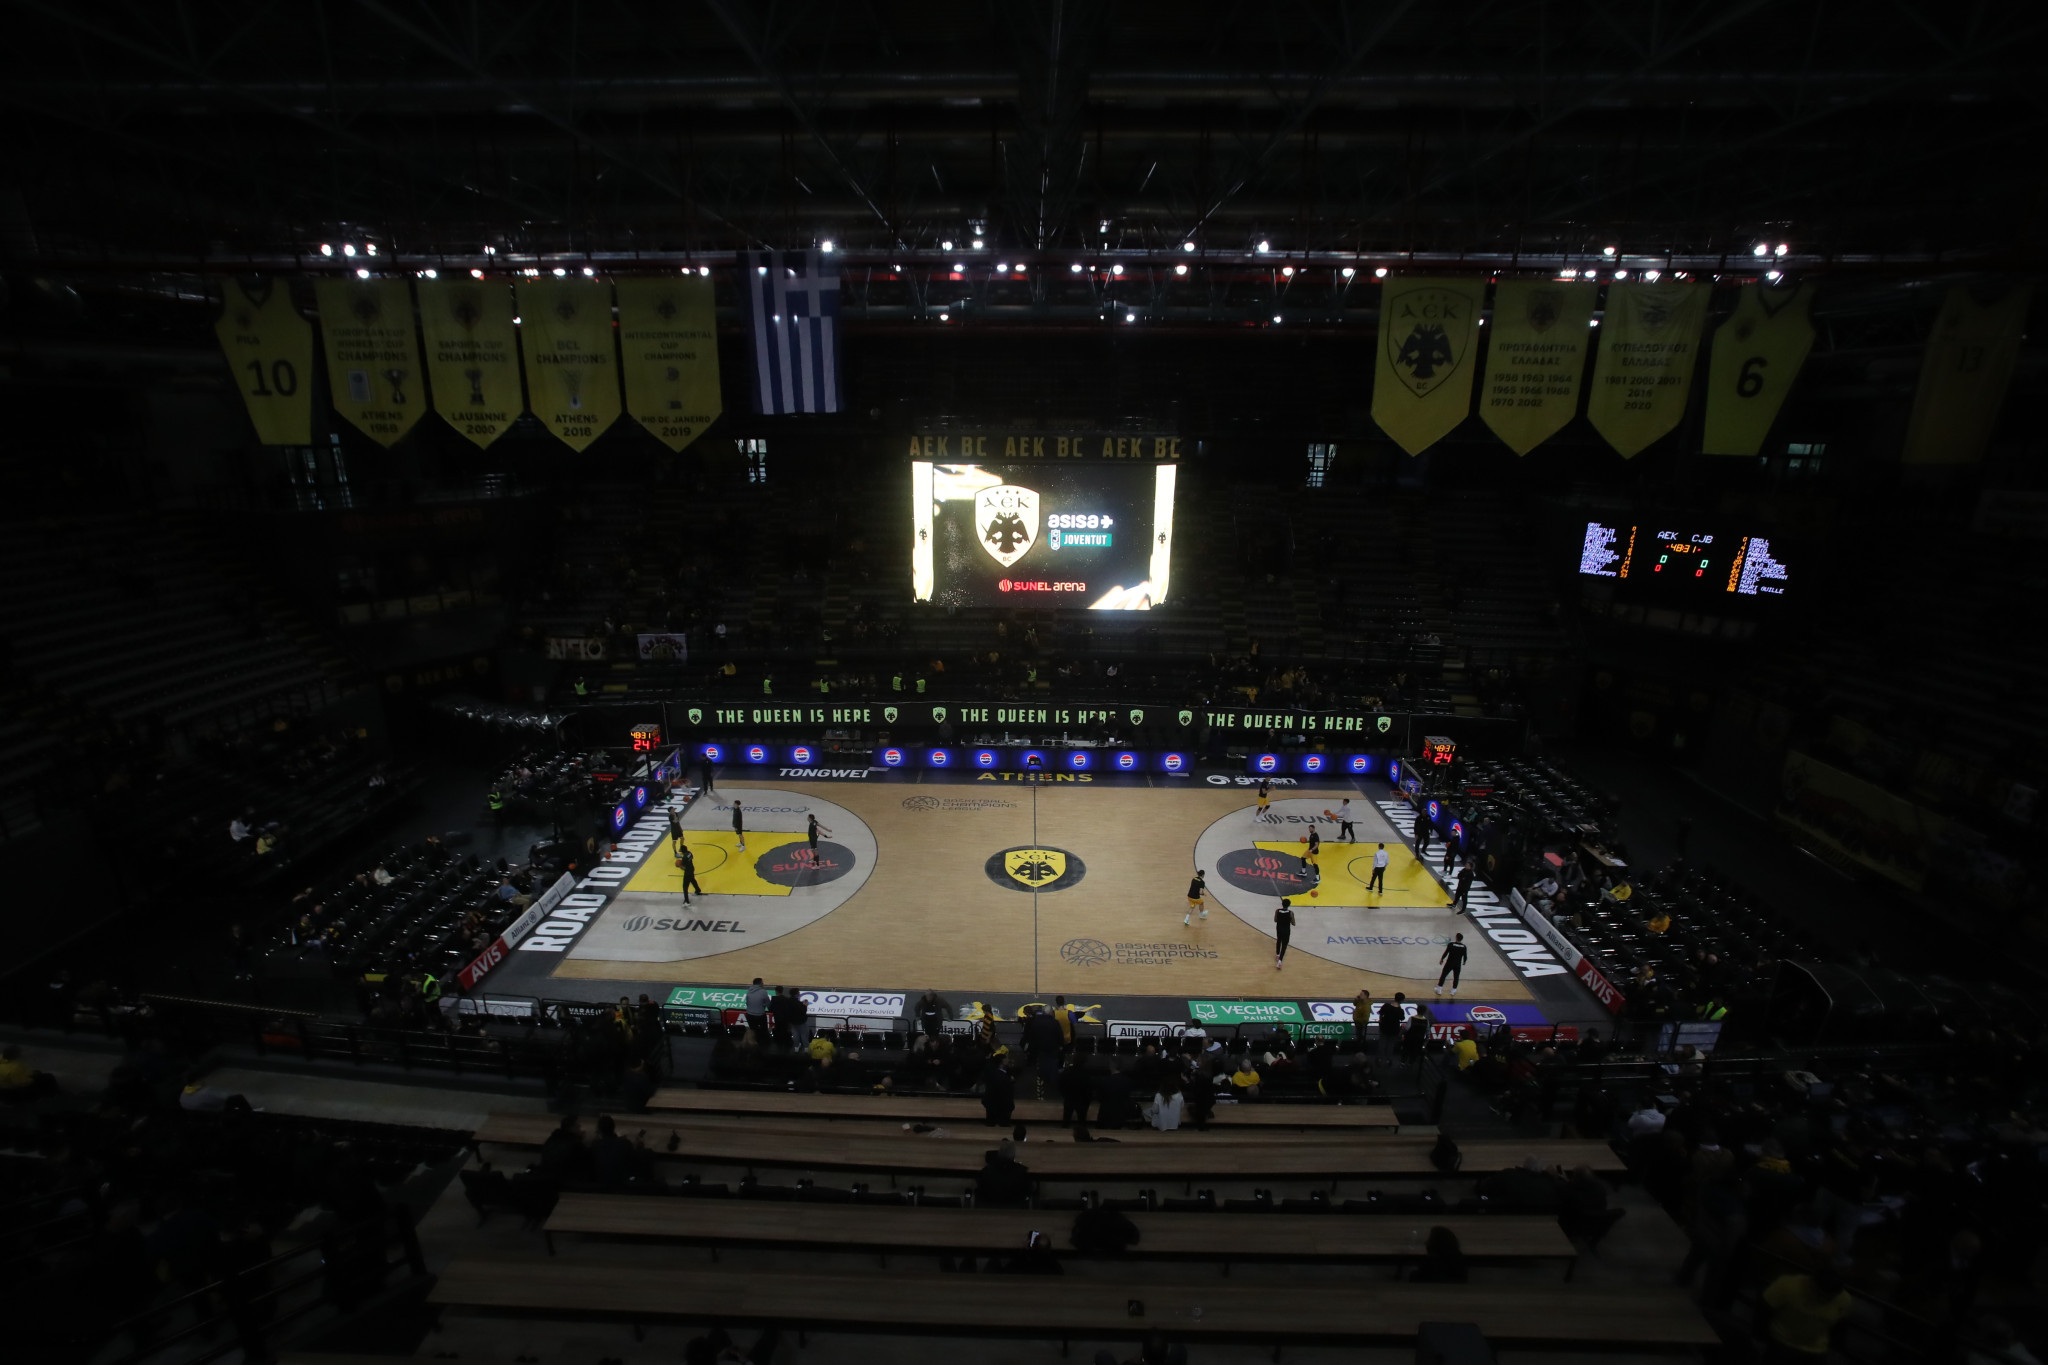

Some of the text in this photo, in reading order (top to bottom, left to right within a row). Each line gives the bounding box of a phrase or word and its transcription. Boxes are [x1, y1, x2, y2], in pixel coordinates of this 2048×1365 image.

[557, 340, 580, 350] BCL
[337, 351, 408, 361] CHAMPIONS
[438, 352, 507, 362] CHAMPIONS
[536, 353, 606, 364] CHAMPIONS
[644, 352, 696, 361] CHAMPIONS
[247, 359, 297, 397] 10
[1737, 357, 1767, 397] 6
[361, 411, 403, 421] ATHENS
[452, 412, 507, 422] LAUSANNE
[555, 413, 598, 424] ATHENS
[563, 427, 592, 437] 2018
[662, 427, 691, 437] 2019
[909, 436, 1181, 458] AEK BC AEK BC AEK BC
[983, 497, 1031, 508] AEK
[1063, 534, 1107, 546] JOVENTUT
[1657, 531, 1714, 543] AEK CJB
[1659, 555, 1709, 569] 0 0
[1654, 564, 1703, 577] 0 0
[1013, 581, 1086, 592] SUNEL arena
[716, 709, 744, 723] THE
[753, 709, 801, 724] QUEEN
[810, 709, 824, 723] IS
[961, 708, 989, 722] THE
[997, 709, 1046, 723] QUEEN
[1055, 710, 1069, 723] IS
[1207, 712, 1364, 731] THE QUEEN IS HERE
[634, 739, 650, 751] 24
[1434, 752, 1452, 764] 24
[779, 768, 869, 778] TONGWEI
[976, 772, 1094, 782] ATHENS
[1234, 867, 1303, 882] SUNEL
[518, 893, 608, 952] ROAD
[576, 866, 631, 888] TO
[511, 919, 530, 940] Allianz
[654, 919, 746, 933] SUNEL
[1115, 942, 1206, 950] BASKETBALL
[1326, 936, 1429, 946] AMERESCO
[1546, 930, 1565, 951] Allianz
[1116, 950, 1218, 959] CHAMPIONS
[471, 945, 502, 983] AVIS
[1581, 969, 1615, 1005] AVIS
[825, 994, 903, 1006] orizon
[1220, 1004, 1296, 1015] VECHRO
[1120, 1027, 1157, 1037] Allianz
[1431, 1024, 1467, 1040] VIS
